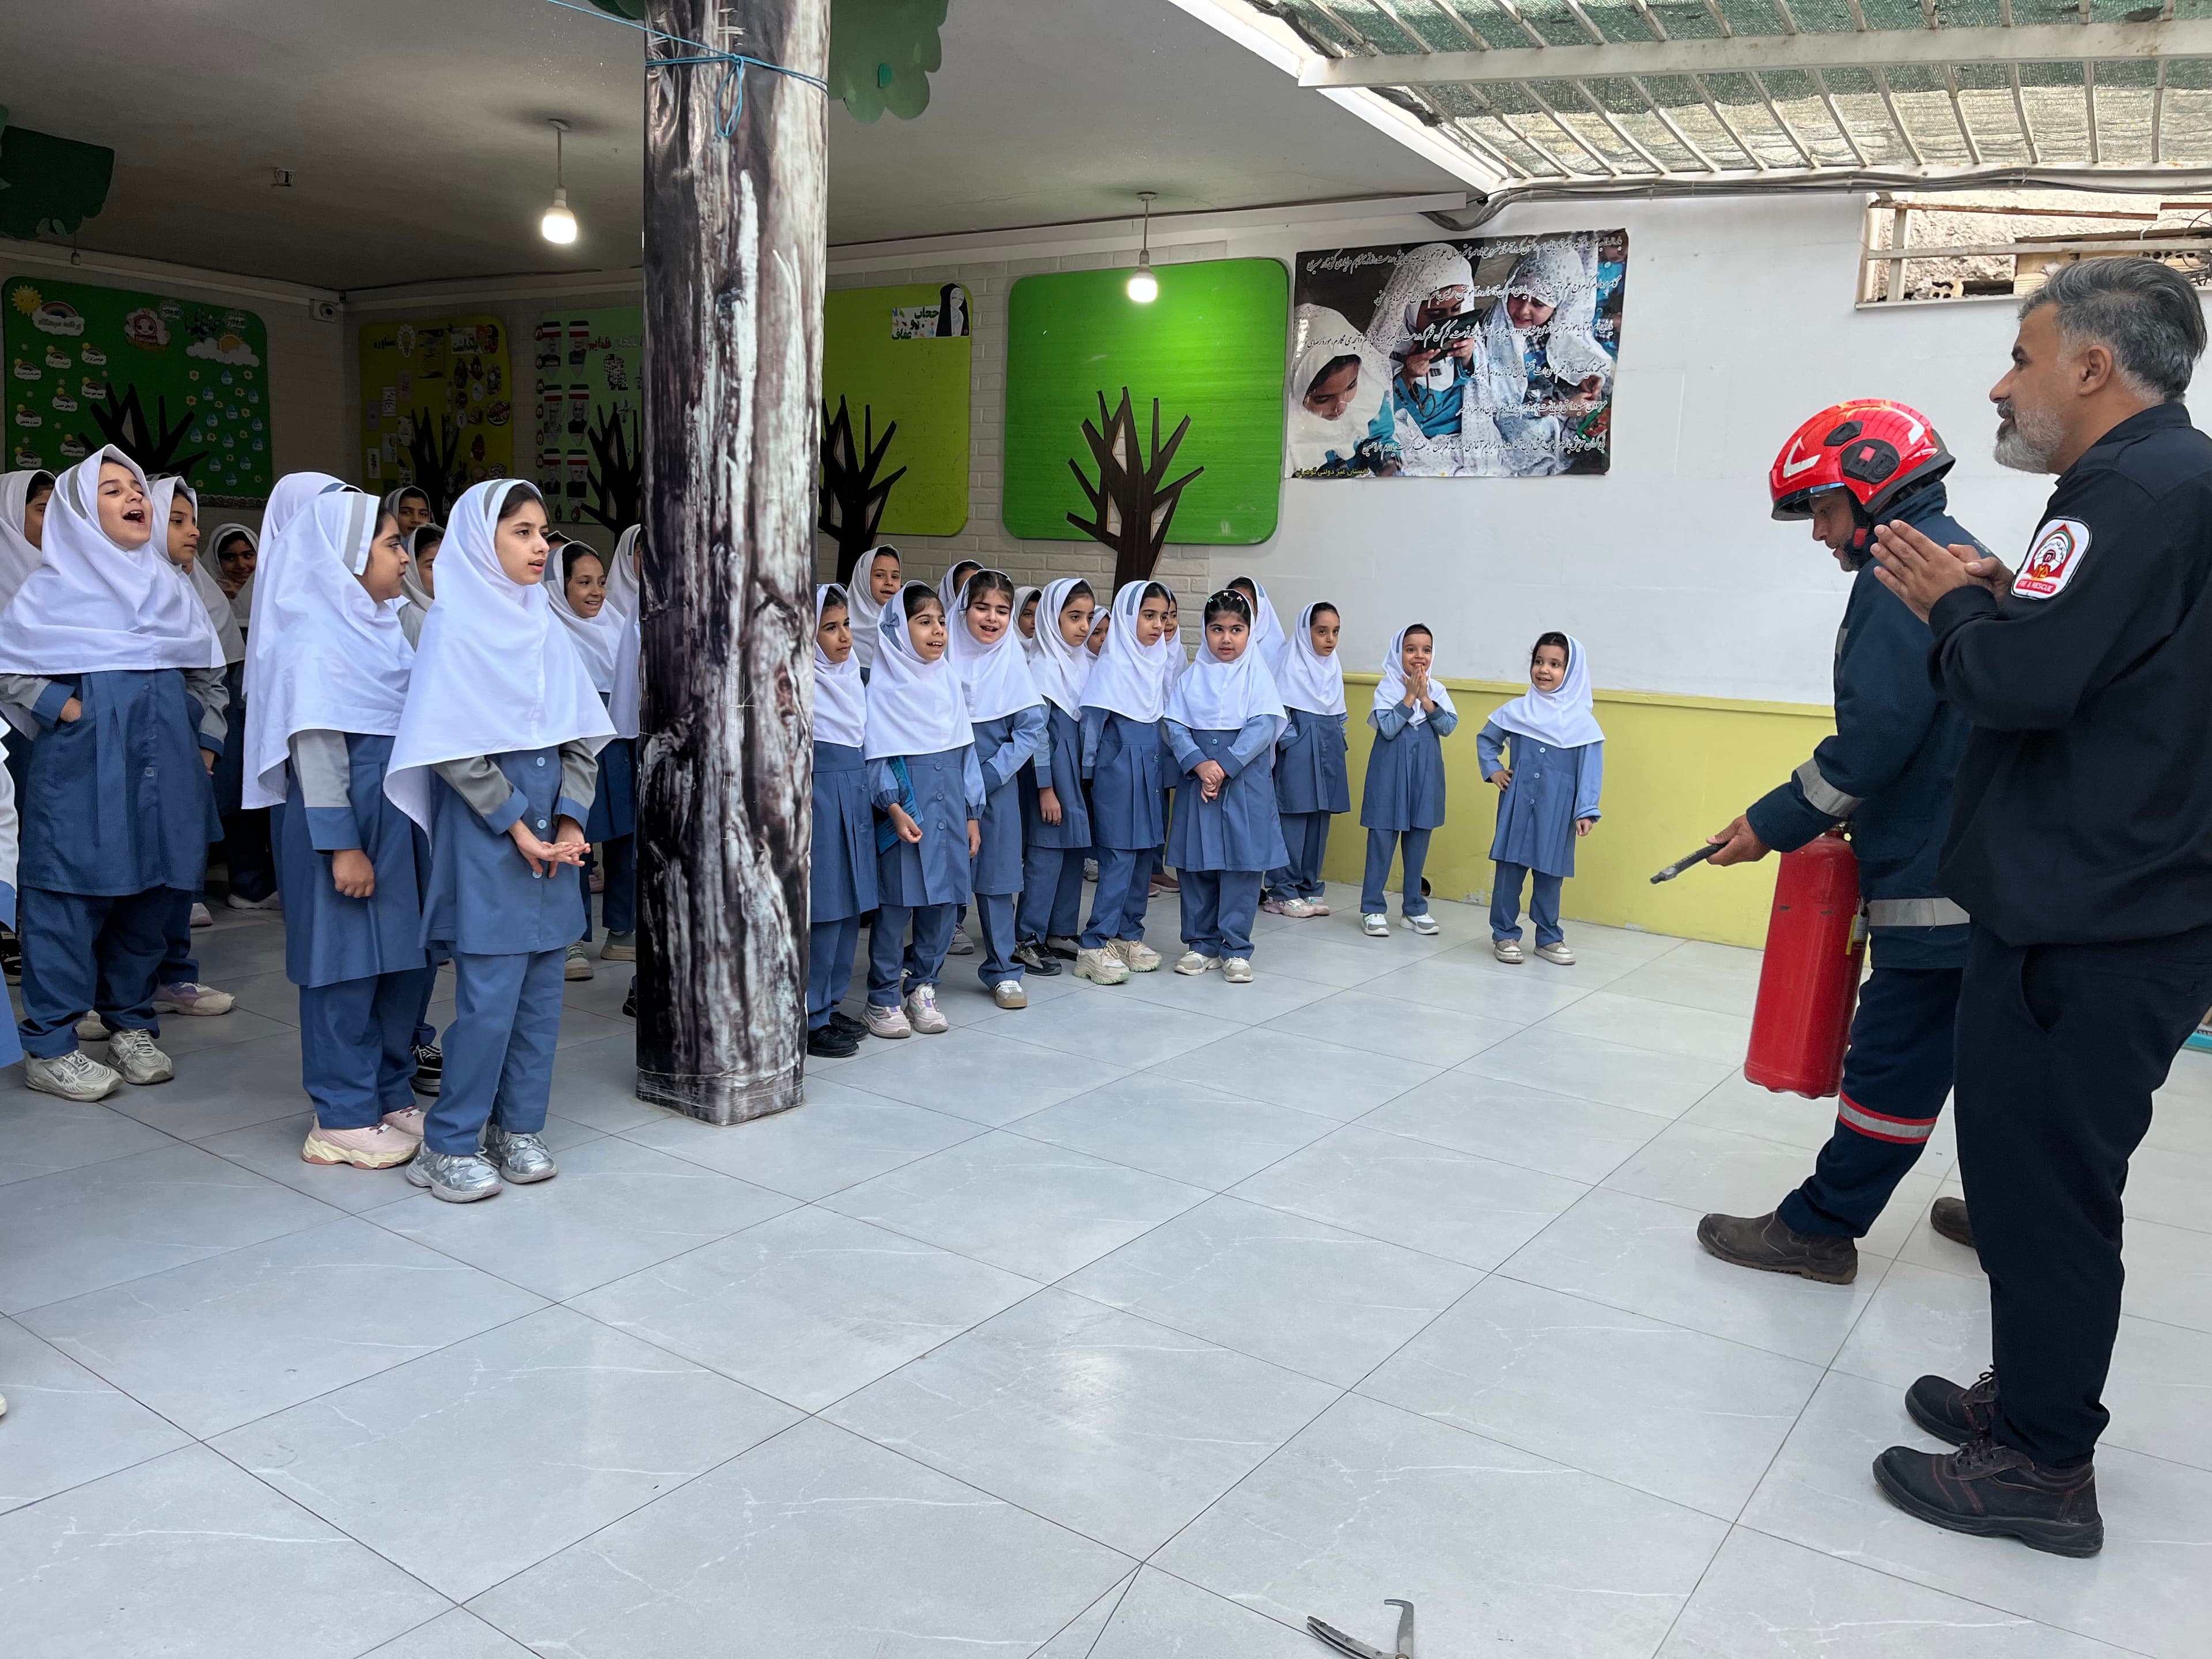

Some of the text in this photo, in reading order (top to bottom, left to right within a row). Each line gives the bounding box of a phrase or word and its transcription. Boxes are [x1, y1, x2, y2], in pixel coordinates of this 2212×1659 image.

[1295, 467, 1369, 479] دبستان غیر دولتی گوهران
[2032, 582, 2054, 592] RESCUE
